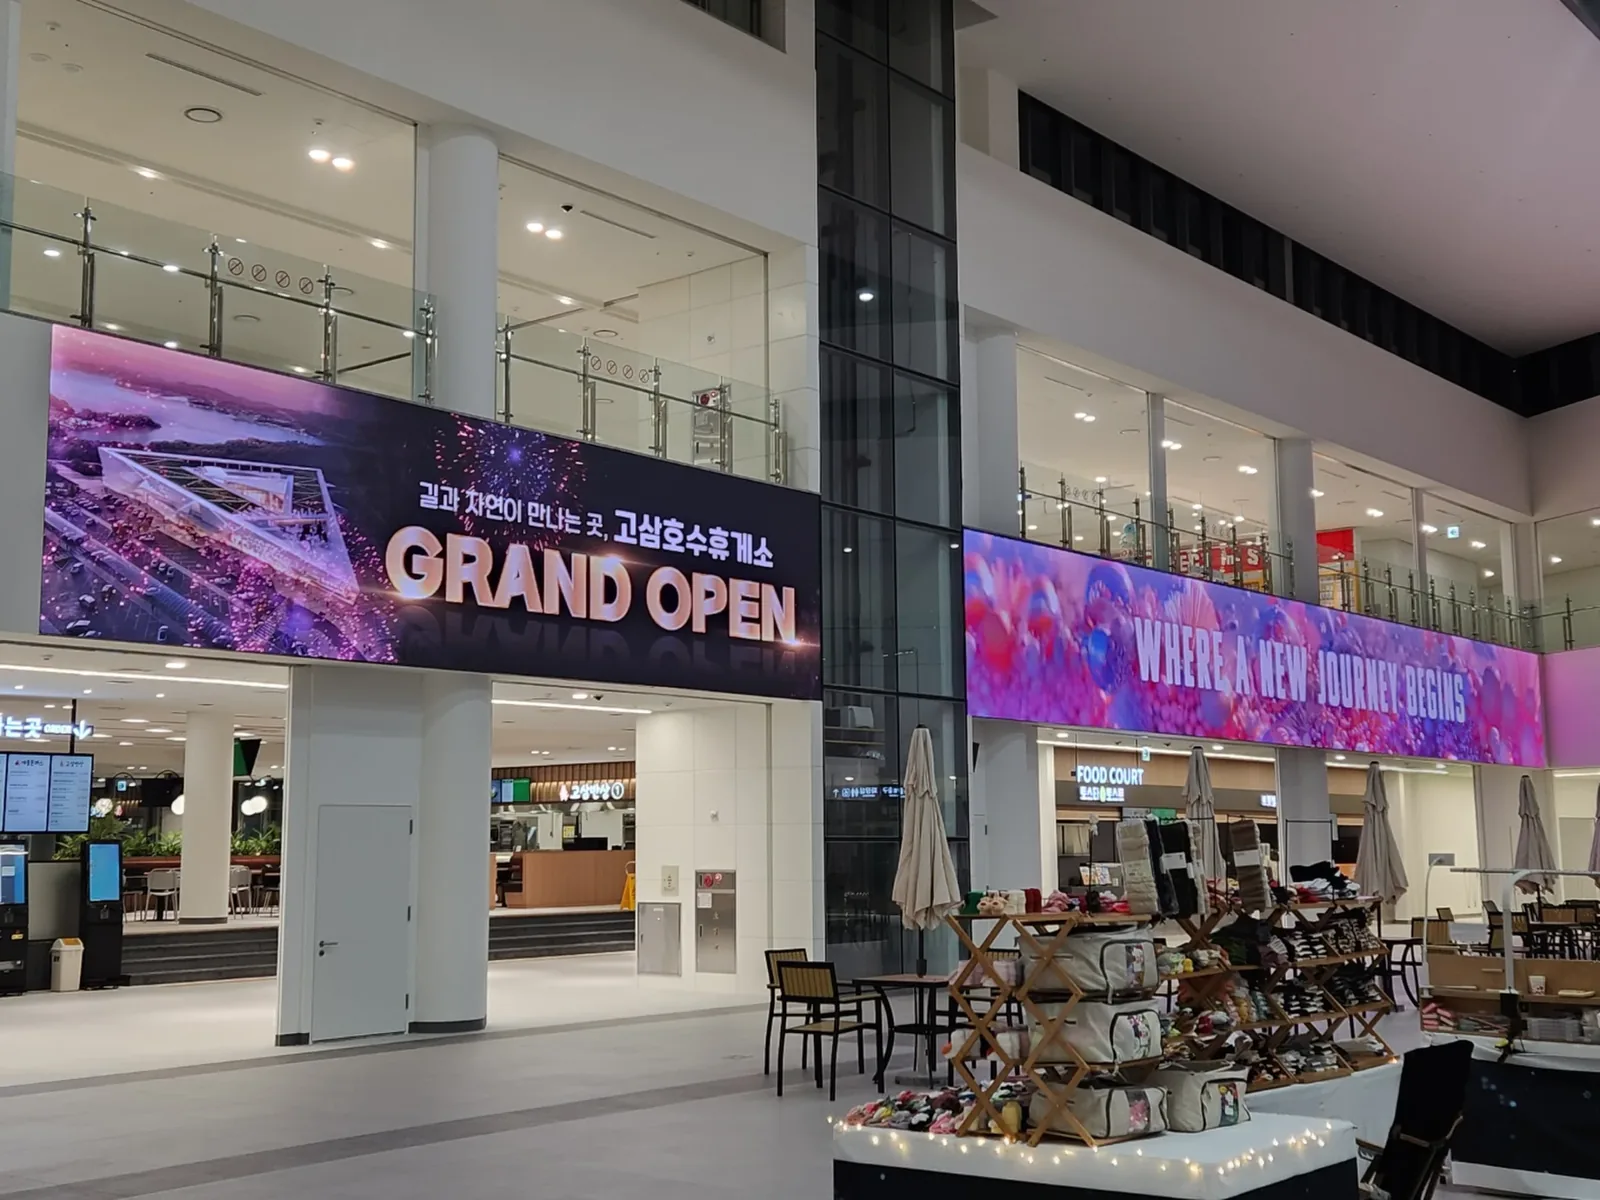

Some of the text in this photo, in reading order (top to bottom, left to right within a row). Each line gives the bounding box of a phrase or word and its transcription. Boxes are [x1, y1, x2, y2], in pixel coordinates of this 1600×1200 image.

[419, 481, 774, 568] 길과 자연이 만나는 곳, 고삼호수휴게소
[385, 525, 797, 643] GRAND OPEN
[1134, 617, 1466, 723] WHERE A NEW JOURNEY BEGINS
[1077, 765, 1144, 786] FOOD COURT
